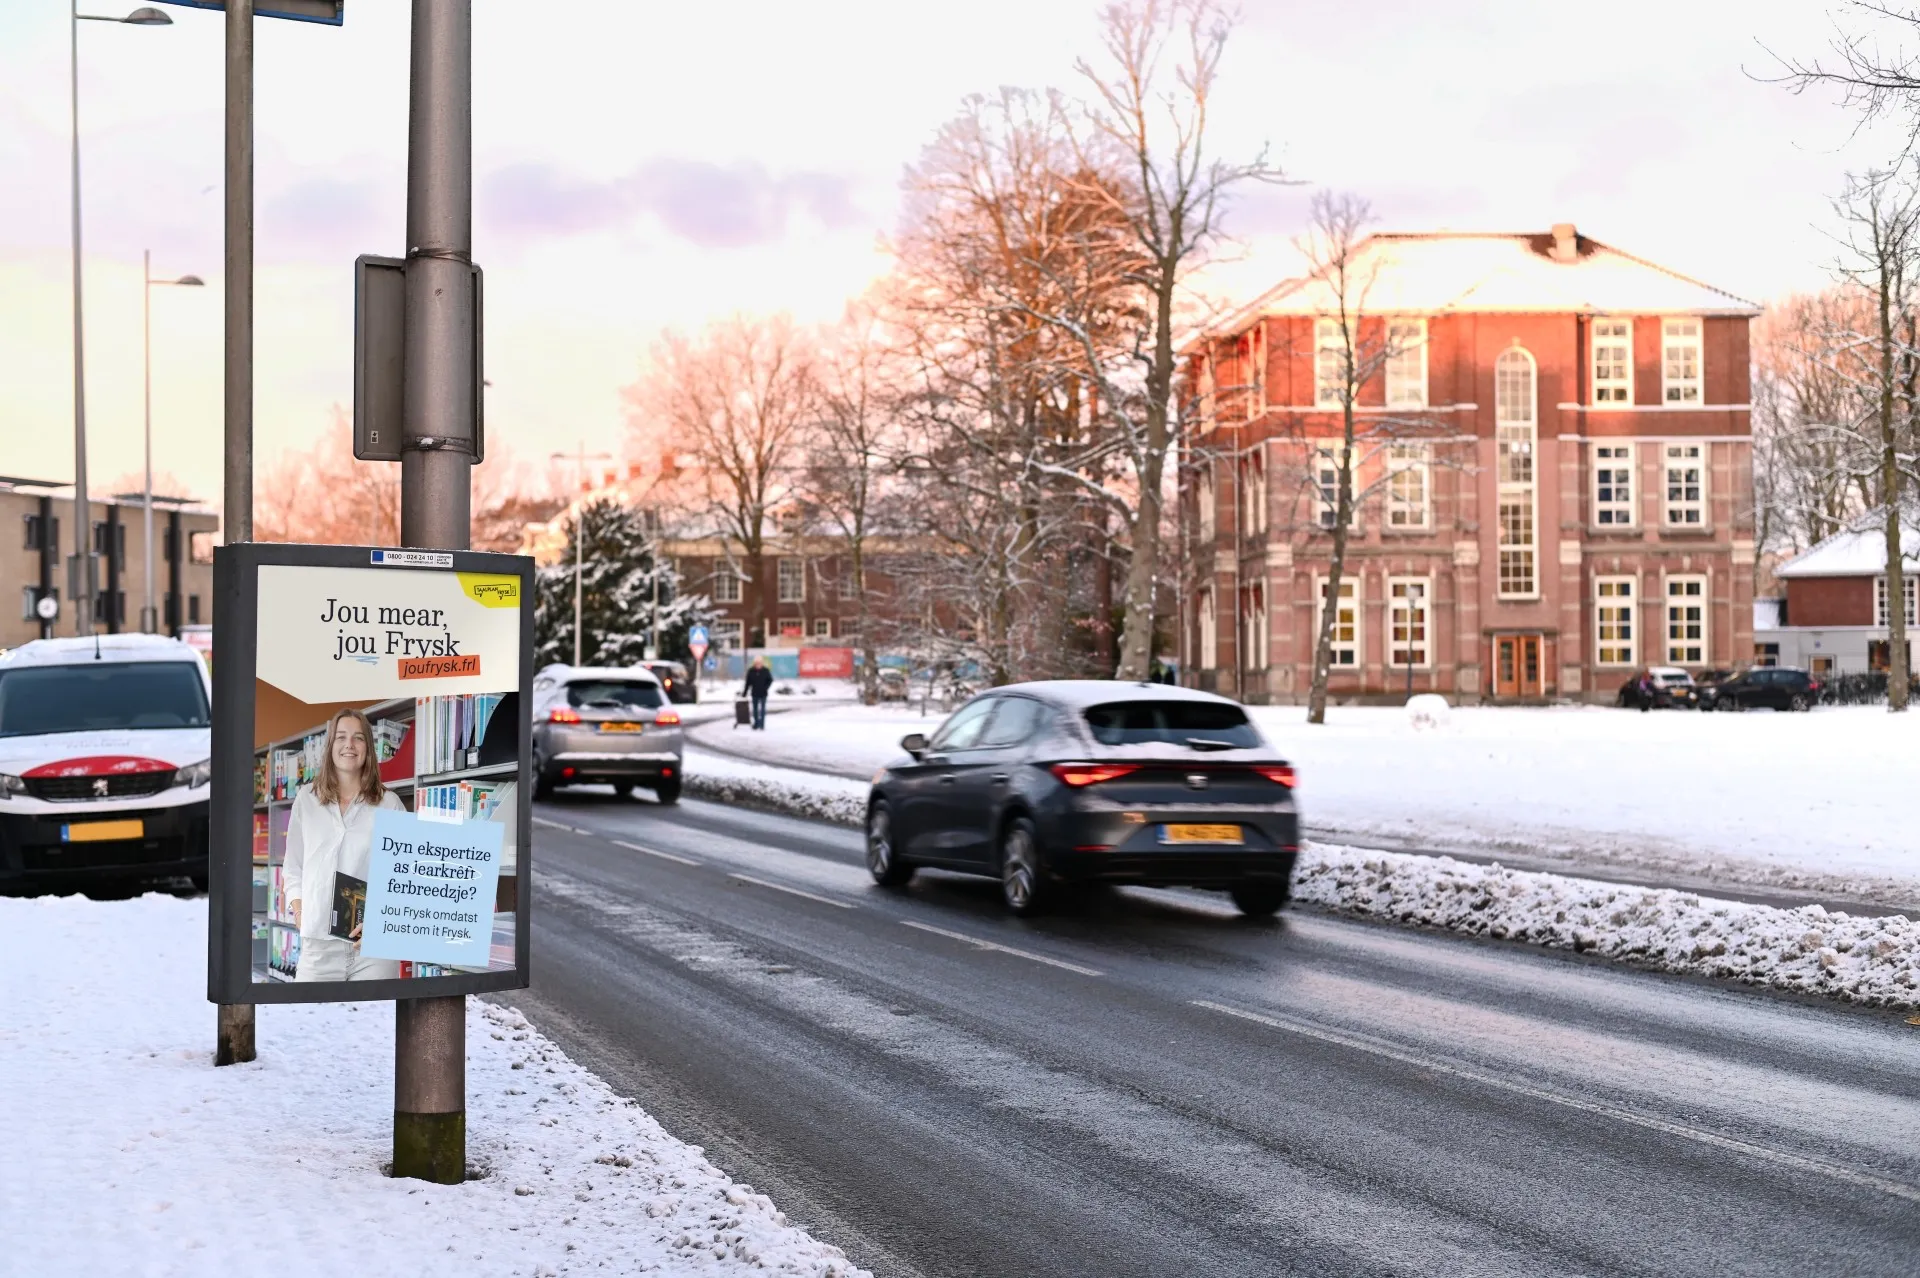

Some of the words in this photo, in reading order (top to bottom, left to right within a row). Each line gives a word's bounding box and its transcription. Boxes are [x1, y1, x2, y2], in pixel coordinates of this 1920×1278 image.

[320, 598, 369, 624] Jou
[378, 606, 448, 631] mear,
[333, 629, 377, 661] jou
[385, 630, 461, 659] Frysk
[402, 658, 476, 678] joufrysk.frl
[381, 836, 413, 856] Dyn
[417, 841, 491, 862] ekspertize
[393, 862, 409, 873] as
[387, 878, 477, 904] ferbreedzje?
[380, 905, 401, 916] Jou
[403, 906, 431, 920] Frysk
[432, 911, 478, 923] omdatst
[383, 921, 411, 934] joust
[412, 926, 430, 936] om
[432, 925, 440, 937] it
[441, 927, 472, 940] Frysk.
